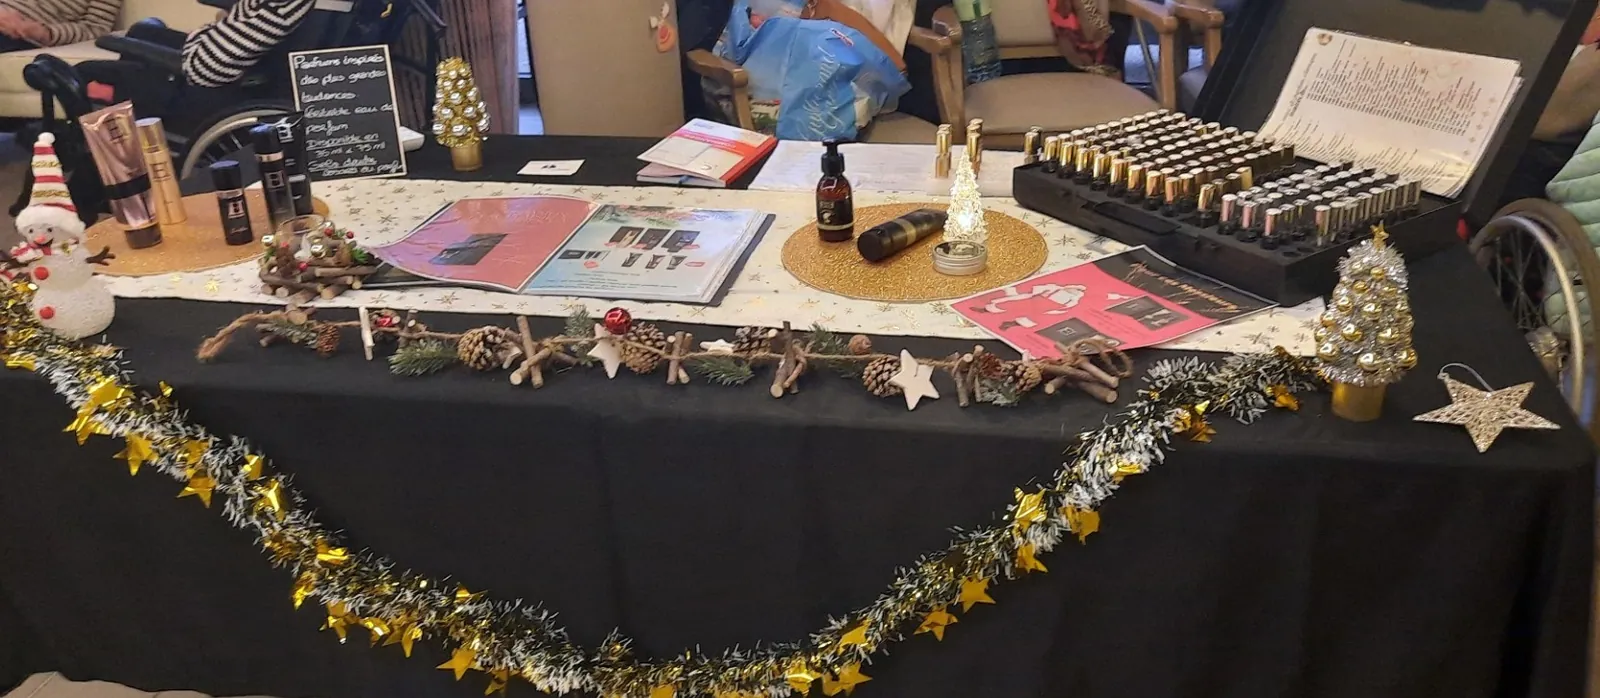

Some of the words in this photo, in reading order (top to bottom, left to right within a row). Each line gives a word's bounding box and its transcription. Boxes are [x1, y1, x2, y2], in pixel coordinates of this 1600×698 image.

[354, 106, 379, 114] eau
[305, 120, 349, 136] parfum
[363, 132, 379, 141] en
